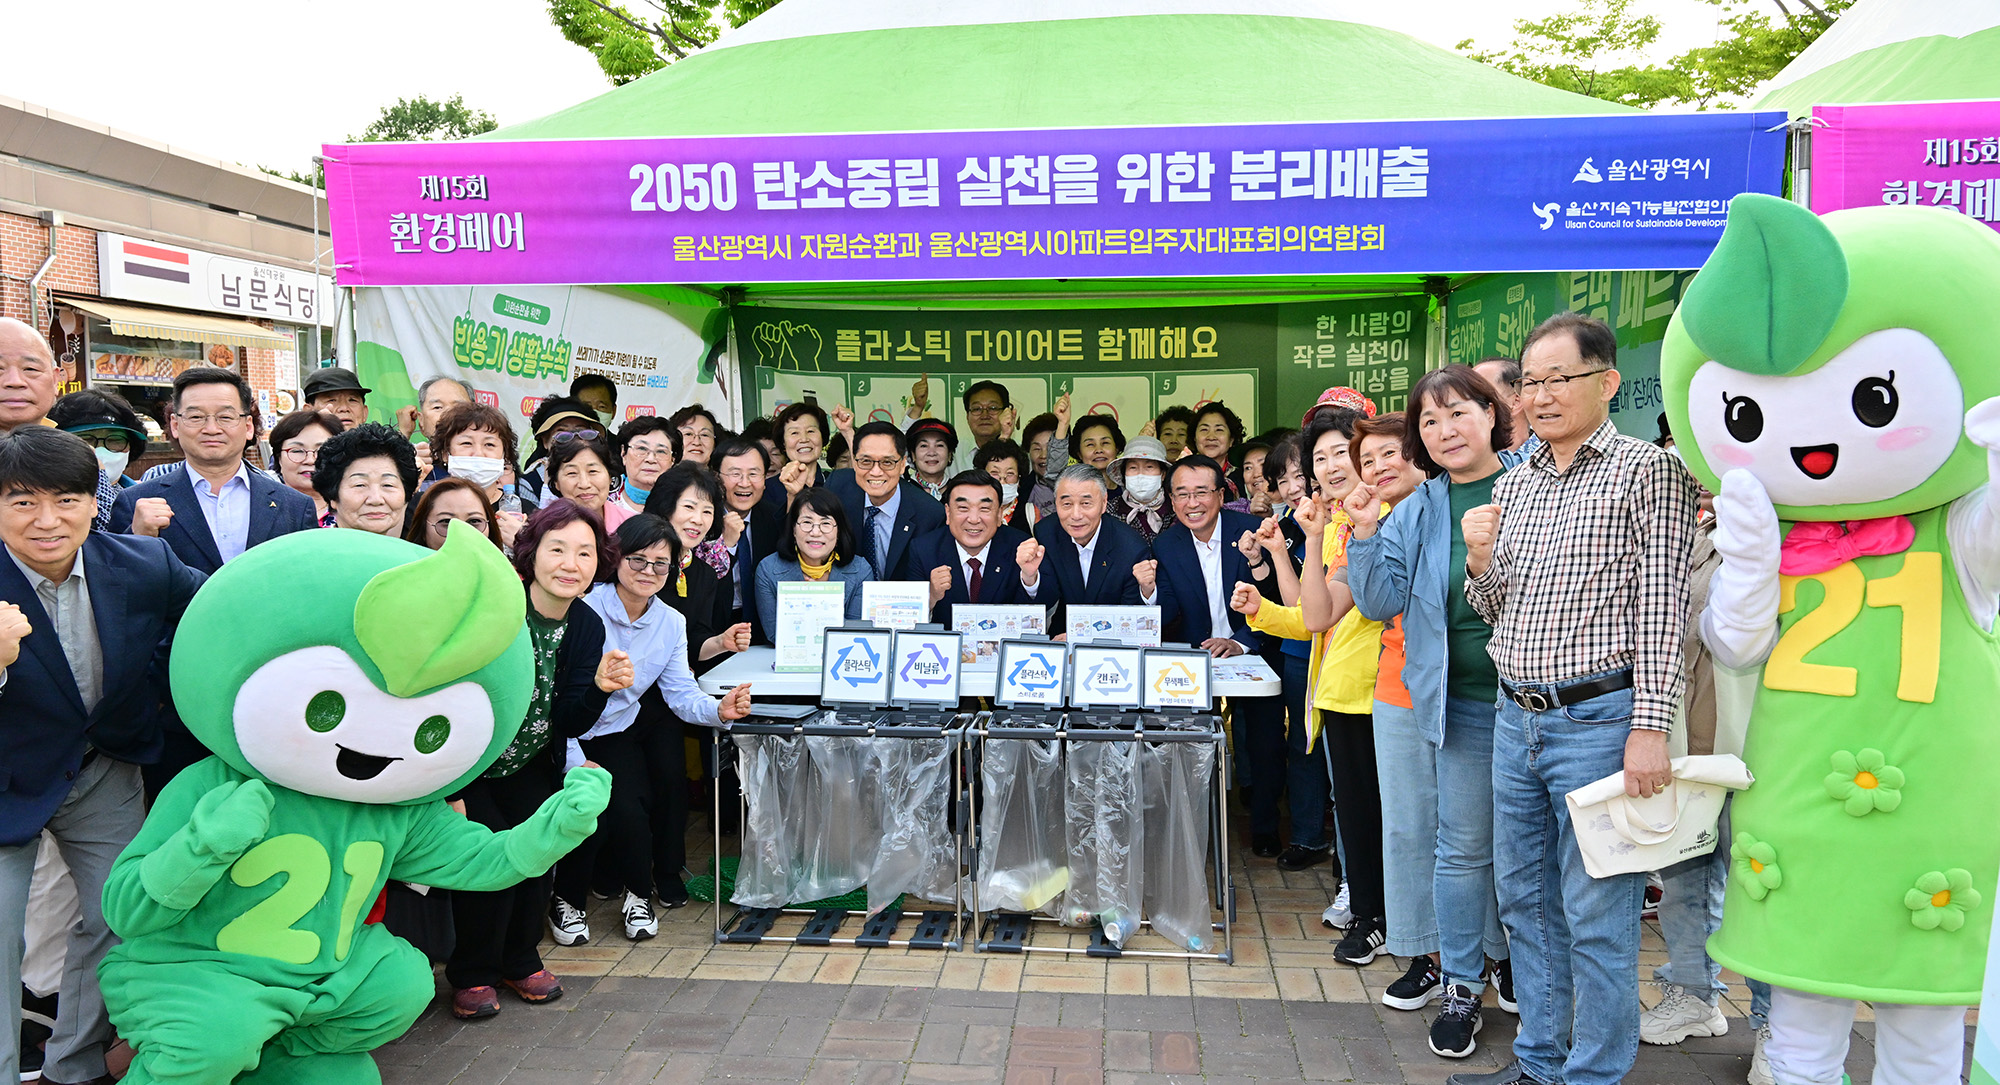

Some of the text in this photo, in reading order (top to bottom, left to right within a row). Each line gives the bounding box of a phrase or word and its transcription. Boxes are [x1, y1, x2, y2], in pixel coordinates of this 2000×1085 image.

[1922, 137, 2000, 166] 제15회
[629, 146, 1430, 212] 2050 탄소중립 실천을 위한 분리배출
[1607, 157, 1710, 182] 울산광역시
[418, 174, 489, 201] 제15회
[1565, 199, 1732, 217] 울산지속가능발전협의
[389, 211, 526, 253] 환경페어
[1565, 219, 1587, 229] Ulsan
[1588, 219, 1620, 229] Council
[1622, 219, 1634, 228] for
[1635, 218, 1683, 228] Sustainable
[672, 224, 1385, 262] 울산광역시 자원순환과 울산광역시아파트입주자대표회의연합회
[221, 273, 315, 319] 남문식당
[504, 299, 541, 320] 자원순환을 위한
[1316, 309, 1412, 340] 한 사람의
[455, 320, 571, 380] 빈용기 생활수칙
[835, 326, 1219, 363] 플라스틱 다이어트 함께해요
[1293, 338, 1409, 369] 작은 실천이
[576, 345, 600, 363] 쓰레기가
[599, 350, 616, 366] 소중한
[616, 352, 632, 367] 자원이
[638, 355, 643, 369] 수
[643, 355, 658, 370] 있도록
[621, 372, 636, 387] 지구의
[636, 374, 646, 387] 스타
[764, 374, 770, 385] 1
[857, 380, 865, 392] 2
[957, 381, 965, 393] 3
[1059, 380, 1067, 392] 4
[1162, 379, 1171, 391] 5
[1348, 366, 1410, 393] 세상을
[523, 399, 534, 413] 02
[627, 407, 635, 419] 04
[1763, 551, 1943, 704] 21
[844, 658, 872, 673] 플라스틱
[914, 661, 940, 676] 비닐류
[1021, 669, 1048, 681] 플라스틱
[1164, 675, 1190, 687] 무색페트
[1018, 691, 1045, 699] 스티로폼
[216, 833, 385, 964] 21
